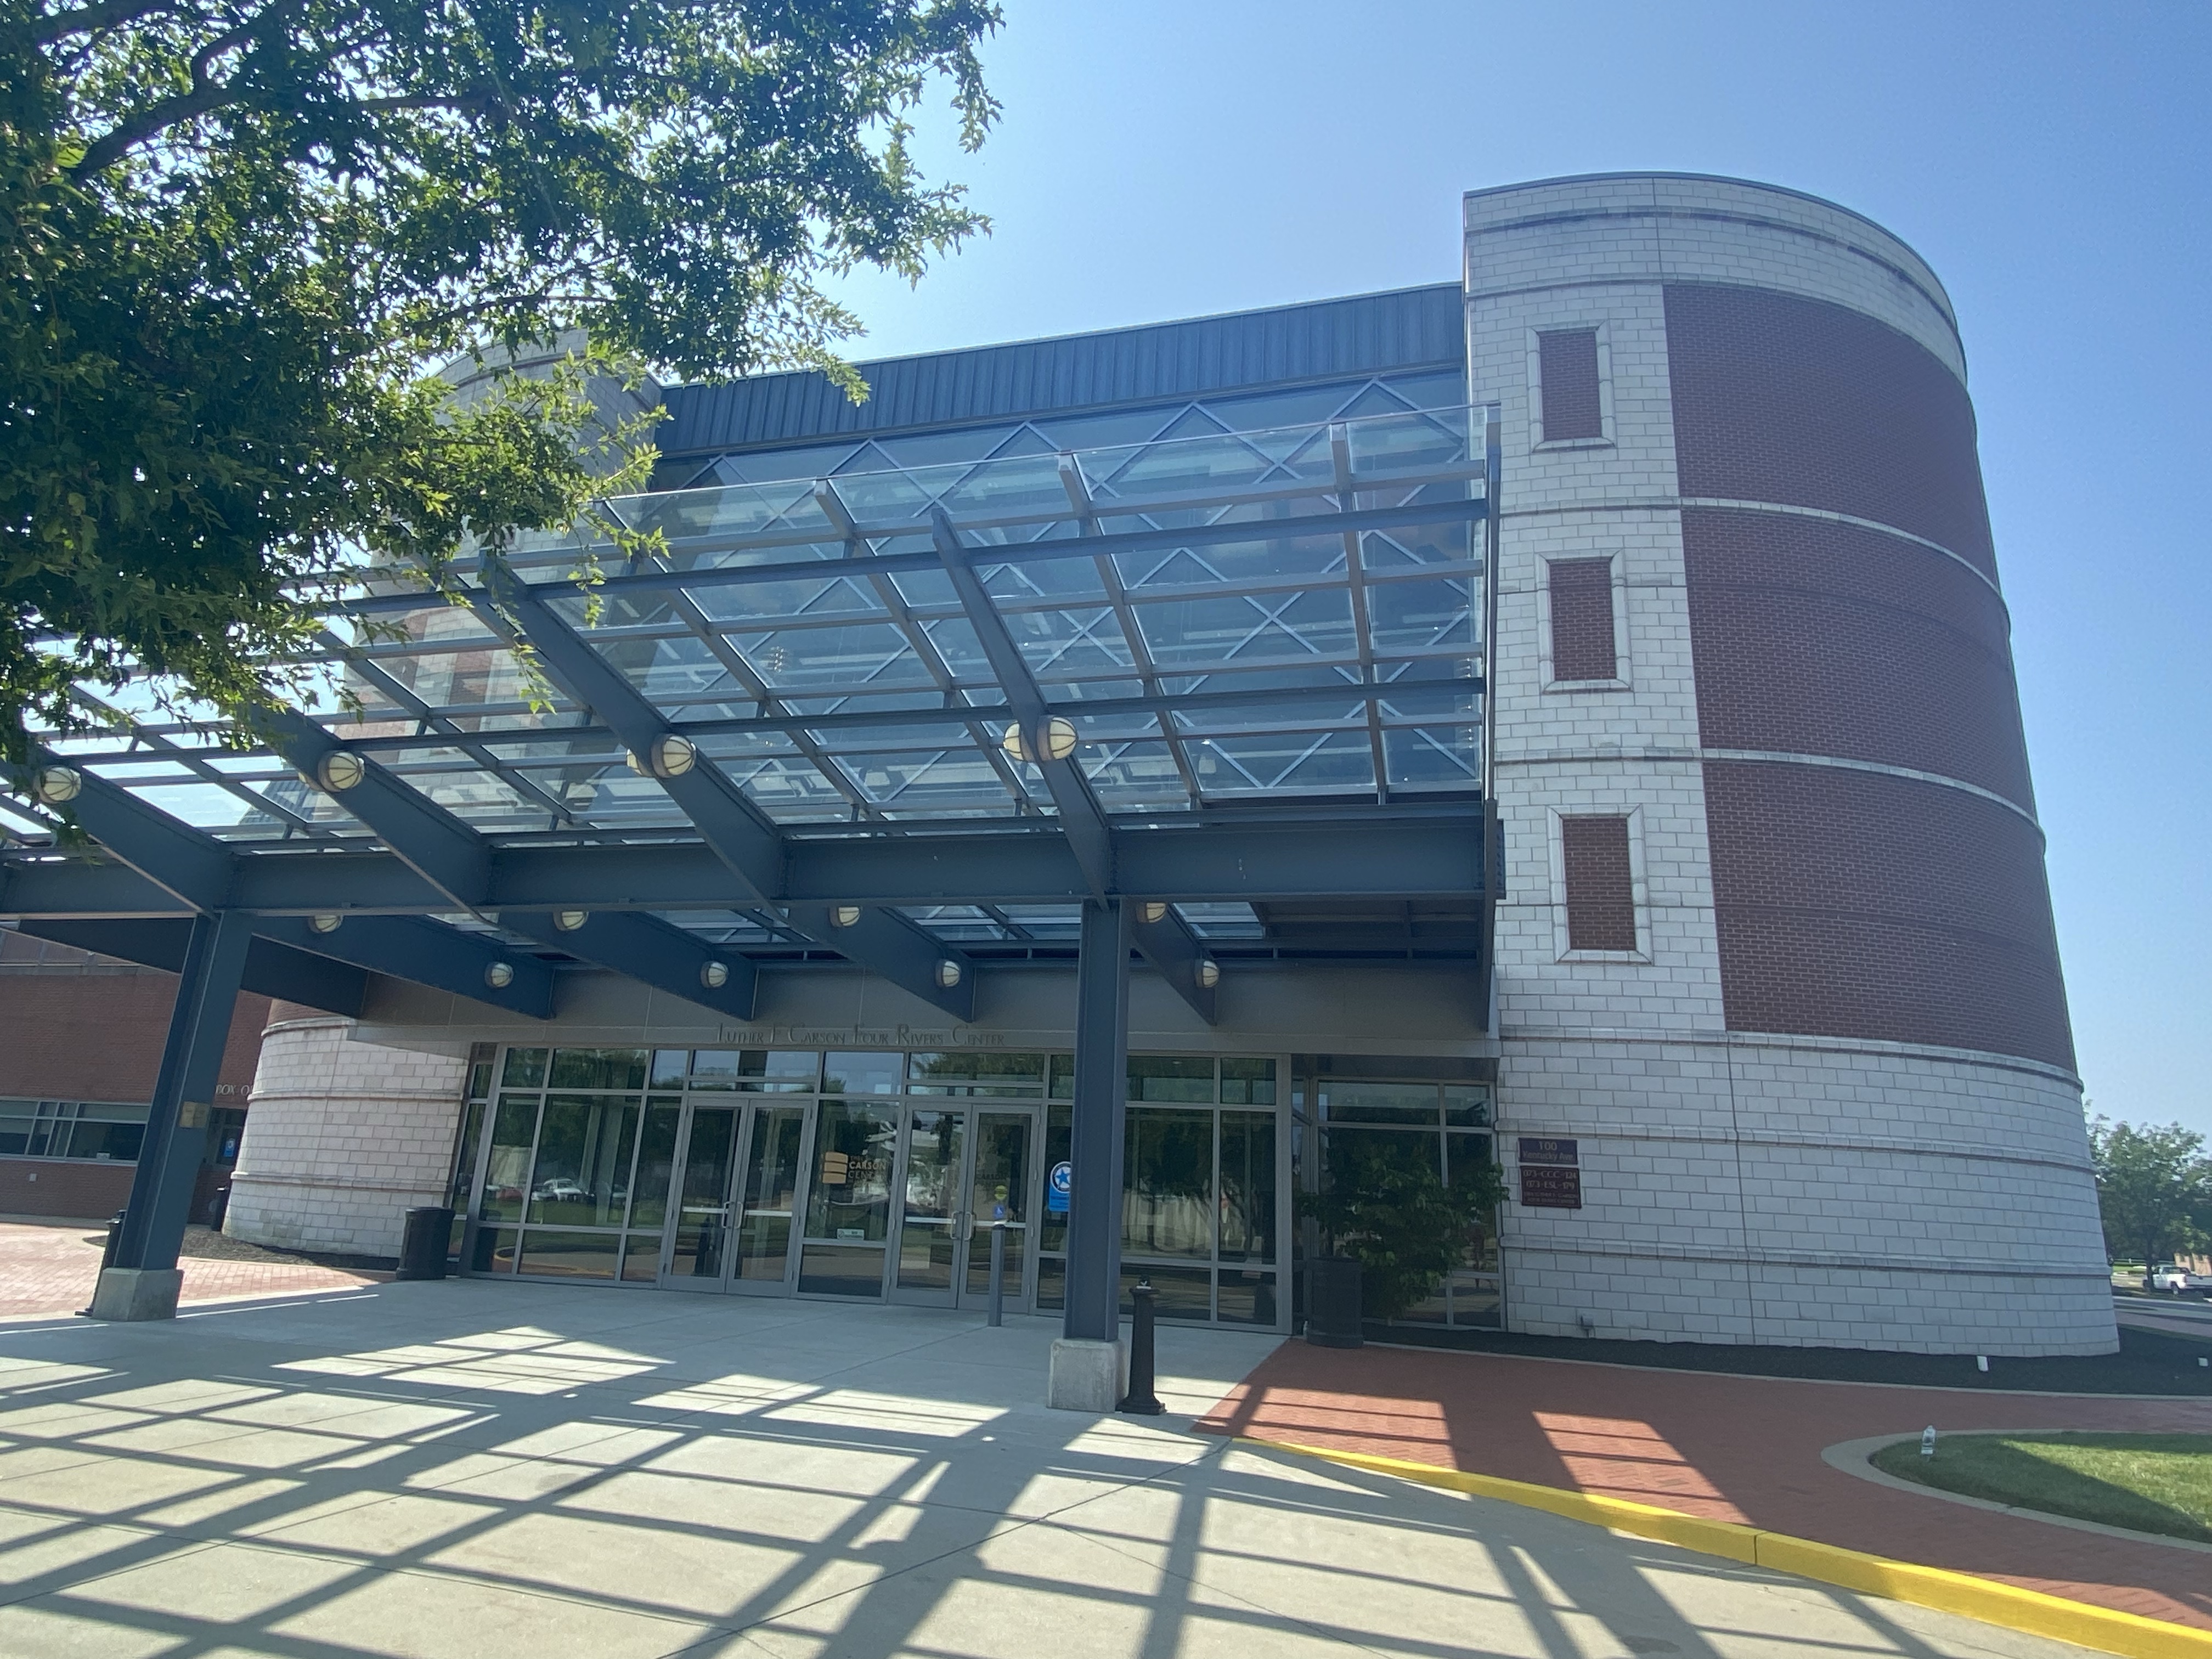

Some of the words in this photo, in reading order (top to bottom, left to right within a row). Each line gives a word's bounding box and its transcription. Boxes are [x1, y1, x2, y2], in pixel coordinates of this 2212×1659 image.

[216, 1084, 236, 1096] BOX
[1539, 1141, 1558, 1150] 100
[849, 1160, 886, 1170] CARSON
